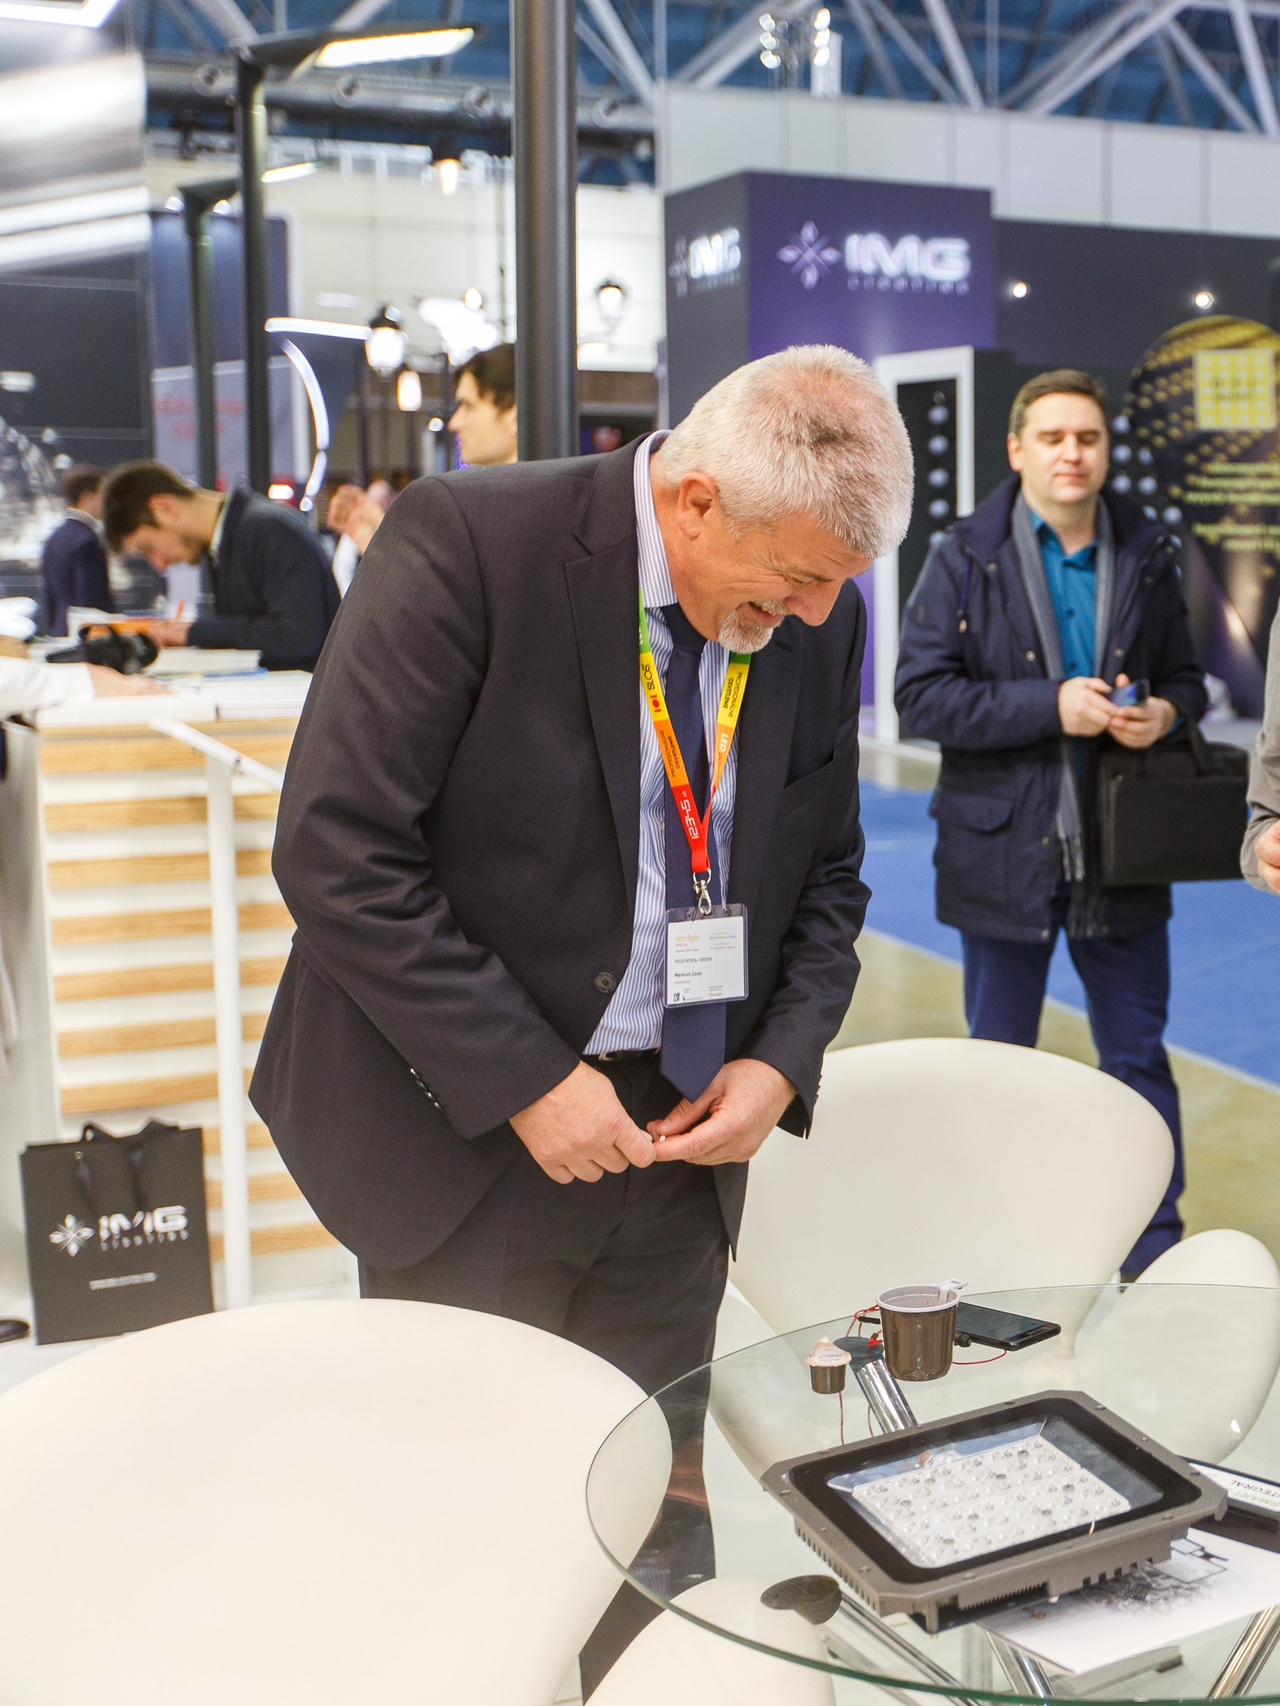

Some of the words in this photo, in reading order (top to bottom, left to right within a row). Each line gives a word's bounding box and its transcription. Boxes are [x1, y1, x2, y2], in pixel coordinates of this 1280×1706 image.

[845, 232, 971, 281] IMG
[720, 732, 729, 752] LED
[98, 1205, 188, 1239] IMG
